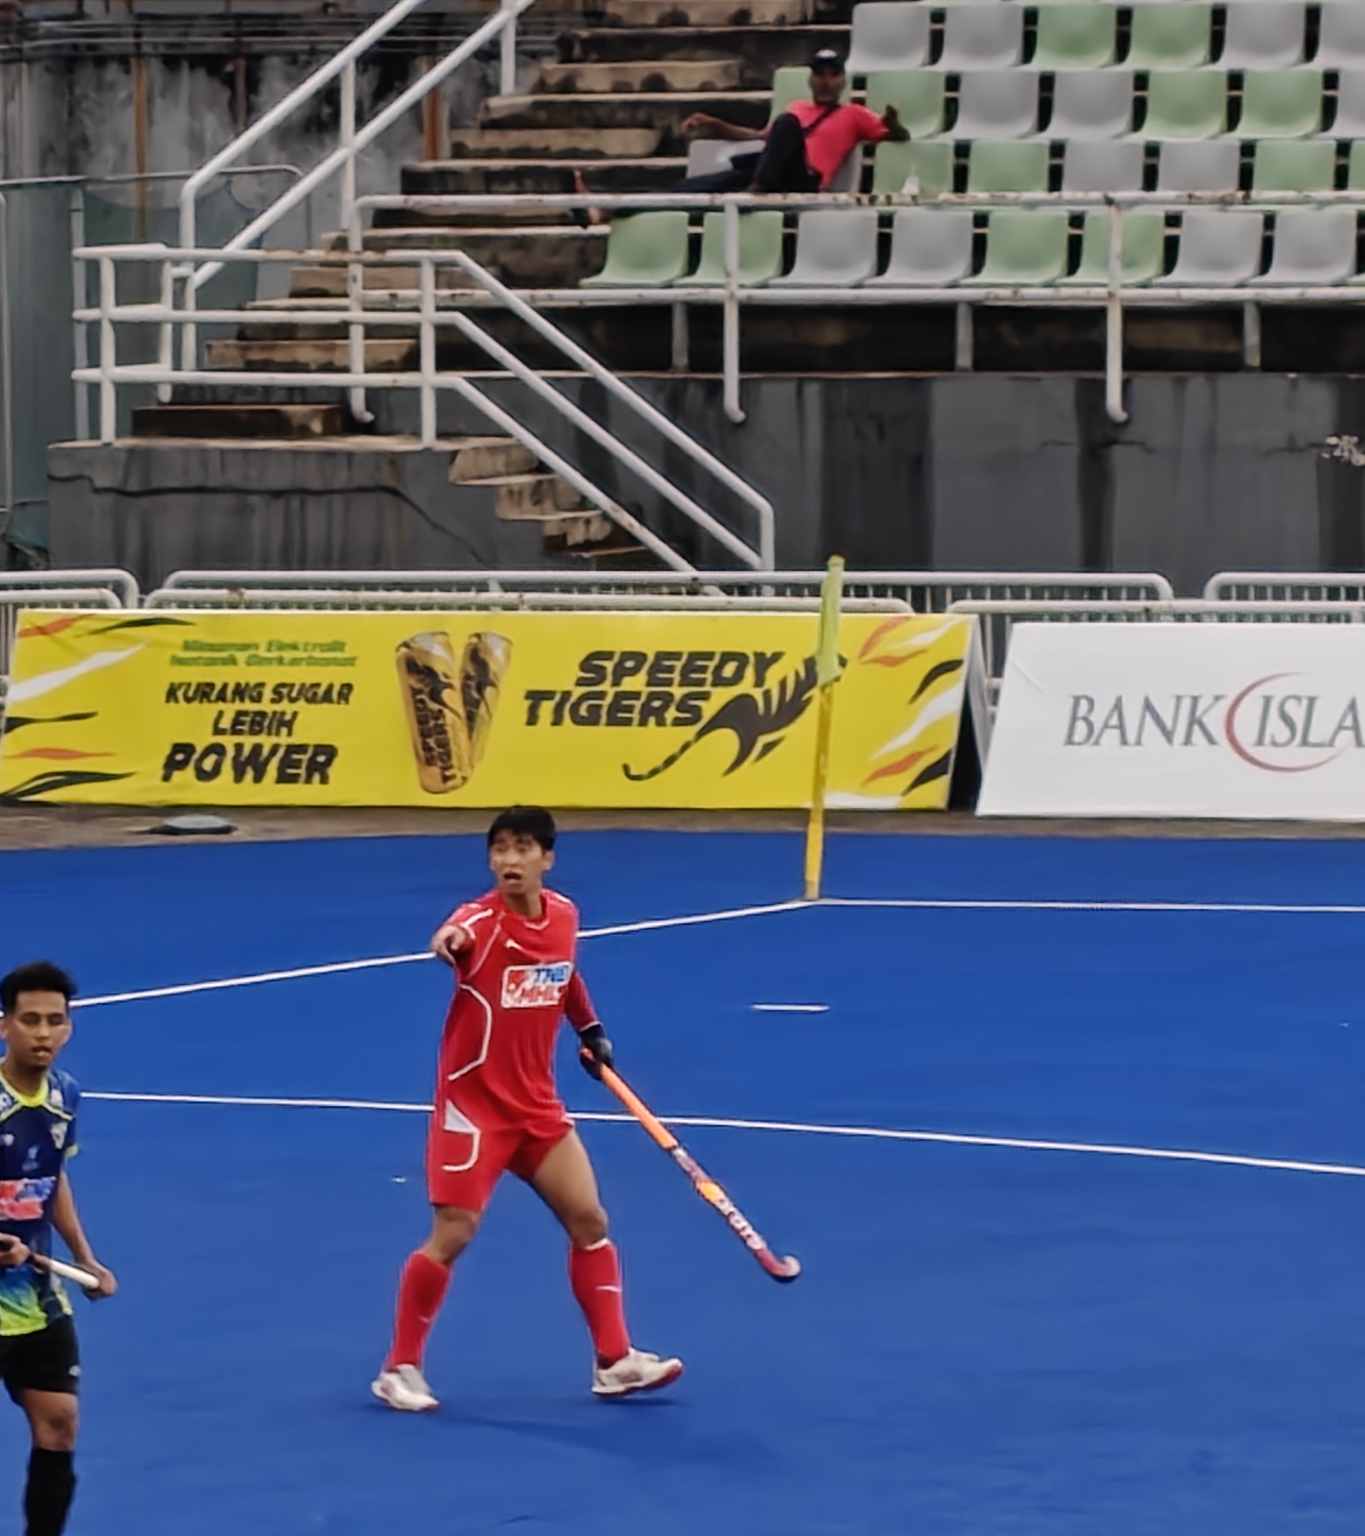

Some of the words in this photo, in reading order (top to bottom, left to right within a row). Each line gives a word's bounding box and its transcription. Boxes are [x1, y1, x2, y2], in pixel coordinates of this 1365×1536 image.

[575, 650, 785, 688] SPEEDY
[165, 681, 266, 704] KURANG
[270, 682, 354, 705] SUGAR
[523, 690, 715, 727] TIGERS
[212, 710, 299, 737] LEBIH
[1063, 694, 1227, 747] BANK
[1253, 694, 1365, 748] ISLA
[162, 741, 339, 785] POWER
